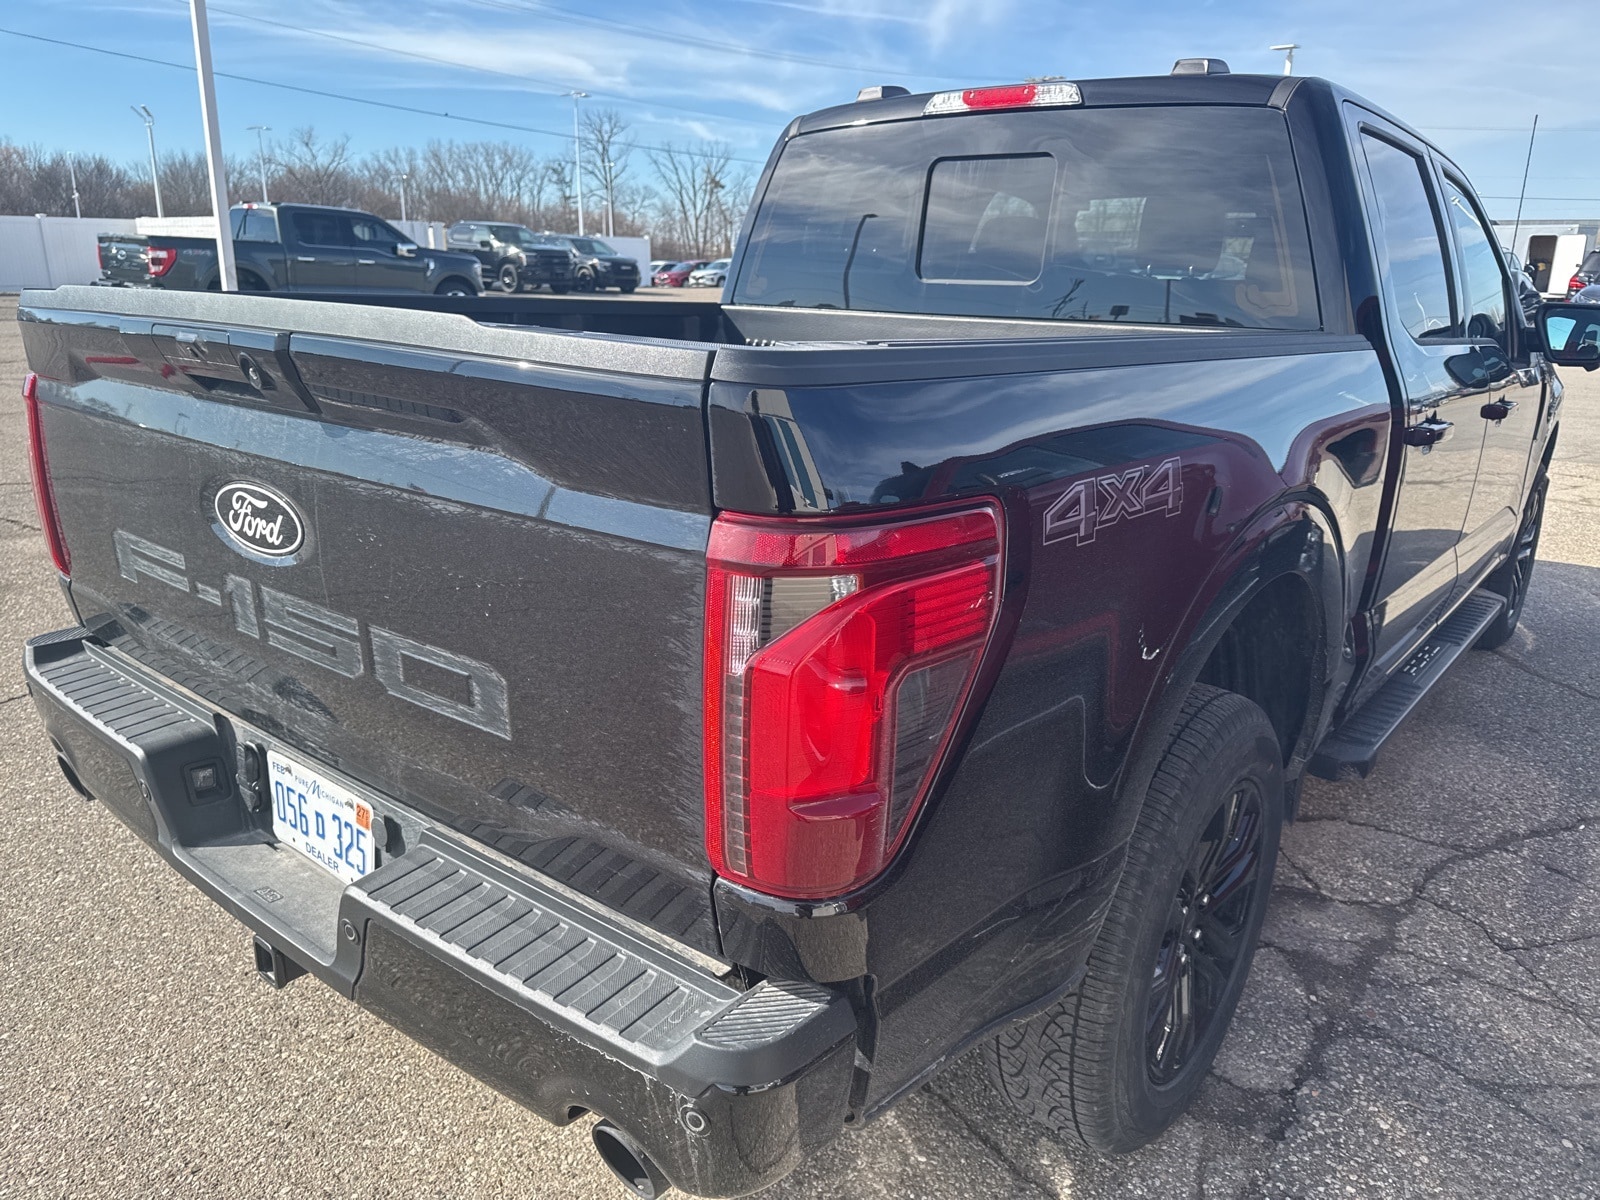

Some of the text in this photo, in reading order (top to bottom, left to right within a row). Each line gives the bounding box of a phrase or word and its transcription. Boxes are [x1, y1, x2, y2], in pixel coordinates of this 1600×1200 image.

[229, 490, 284, 545] Ford
[113, 529, 511, 740] F-150
[272, 761, 286, 775] FEB
[295, 775, 309, 787] PURE
[356, 805, 365, 818] 27
[275, 780, 366, 875] 056 D 325
[306, 842, 339, 873] DEALER
